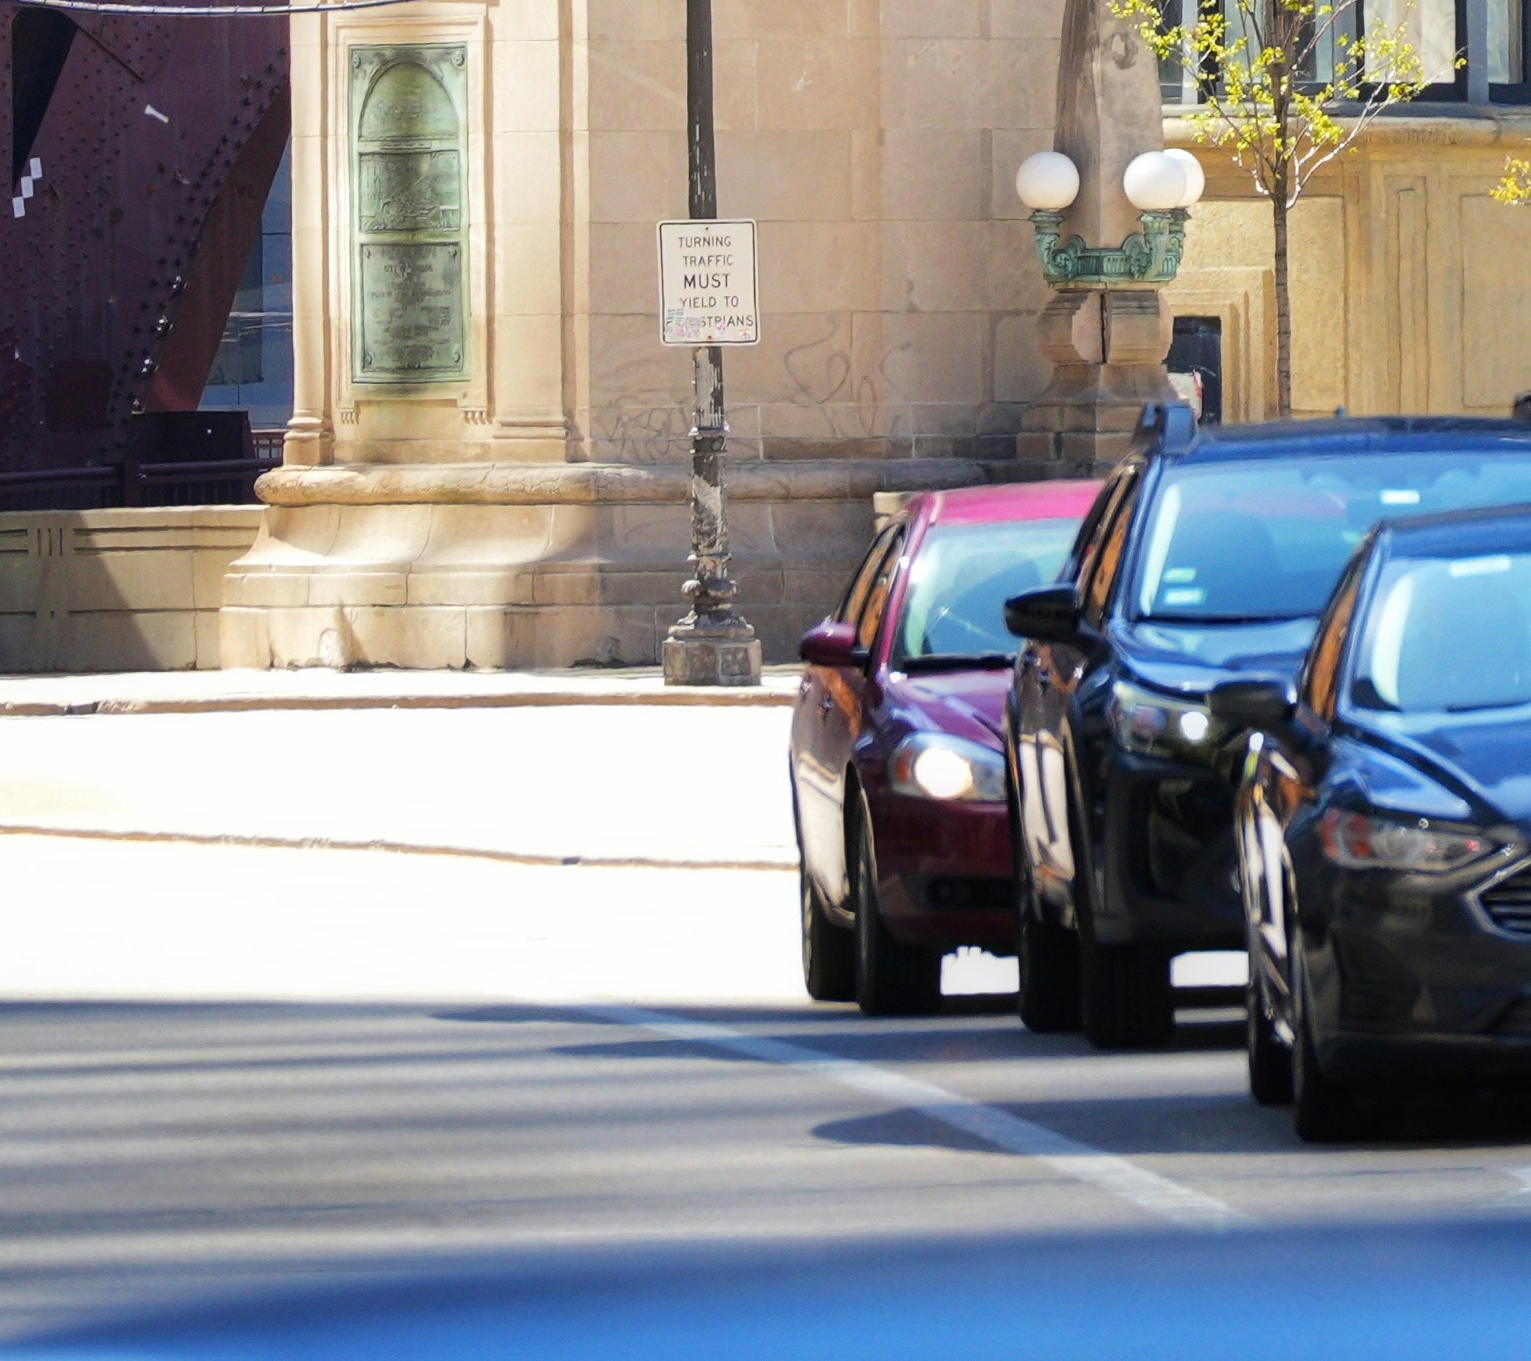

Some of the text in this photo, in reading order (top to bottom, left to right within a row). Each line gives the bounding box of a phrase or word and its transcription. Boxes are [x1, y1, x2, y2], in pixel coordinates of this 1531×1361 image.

[677, 236, 732, 249] TURNING
[682, 254, 734, 267] TRAFFIC
[683, 273, 731, 289] MUST
[679, 295, 739, 309] YIELD TO
